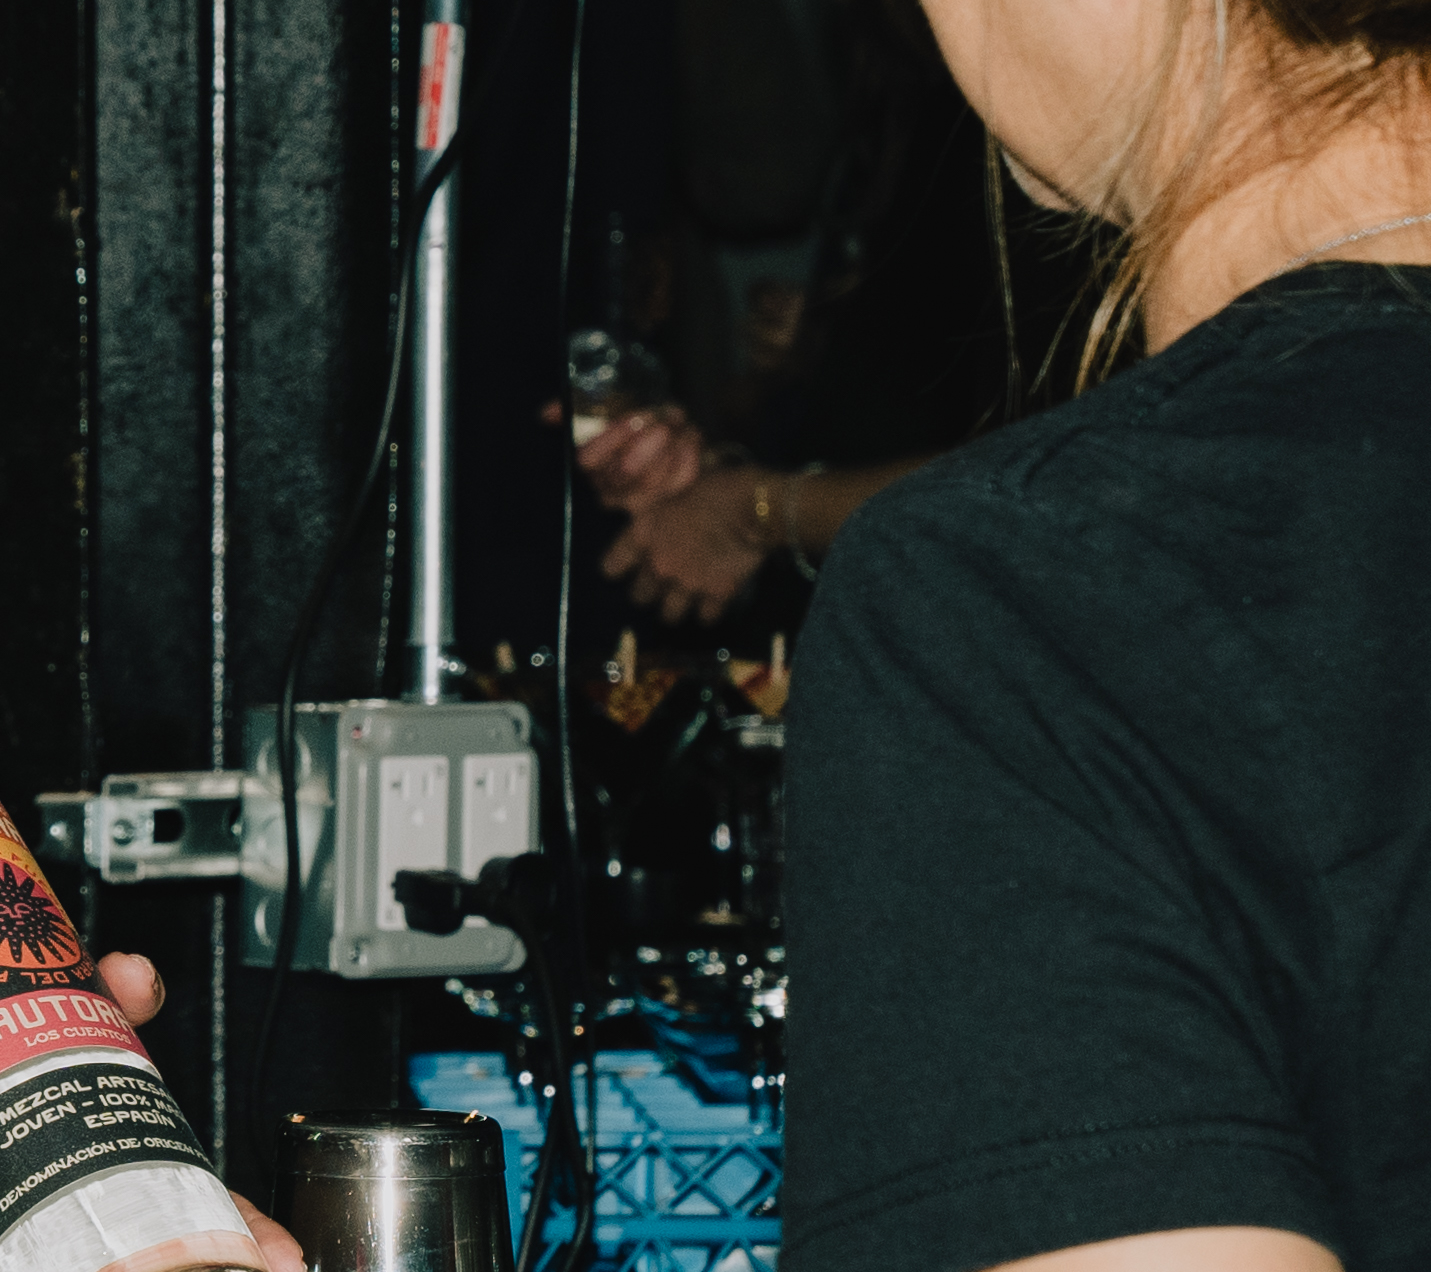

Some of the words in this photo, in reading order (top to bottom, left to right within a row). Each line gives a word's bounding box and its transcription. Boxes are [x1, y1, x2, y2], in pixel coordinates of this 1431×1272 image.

[20, 971, 70, 985] DEL
[23, 1030, 60, 1047] LOS
[62, 1026, 132, 1045] CUENTOS
[0, 1101, 77, 1149] JOVEN
[99, 1093, 151, 1107] 100%
[83, 1108, 177, 1129] ESPADÍN
[116, 1138, 141, 1150] DE
[143, 1137, 195, 1156] ORIGEN
